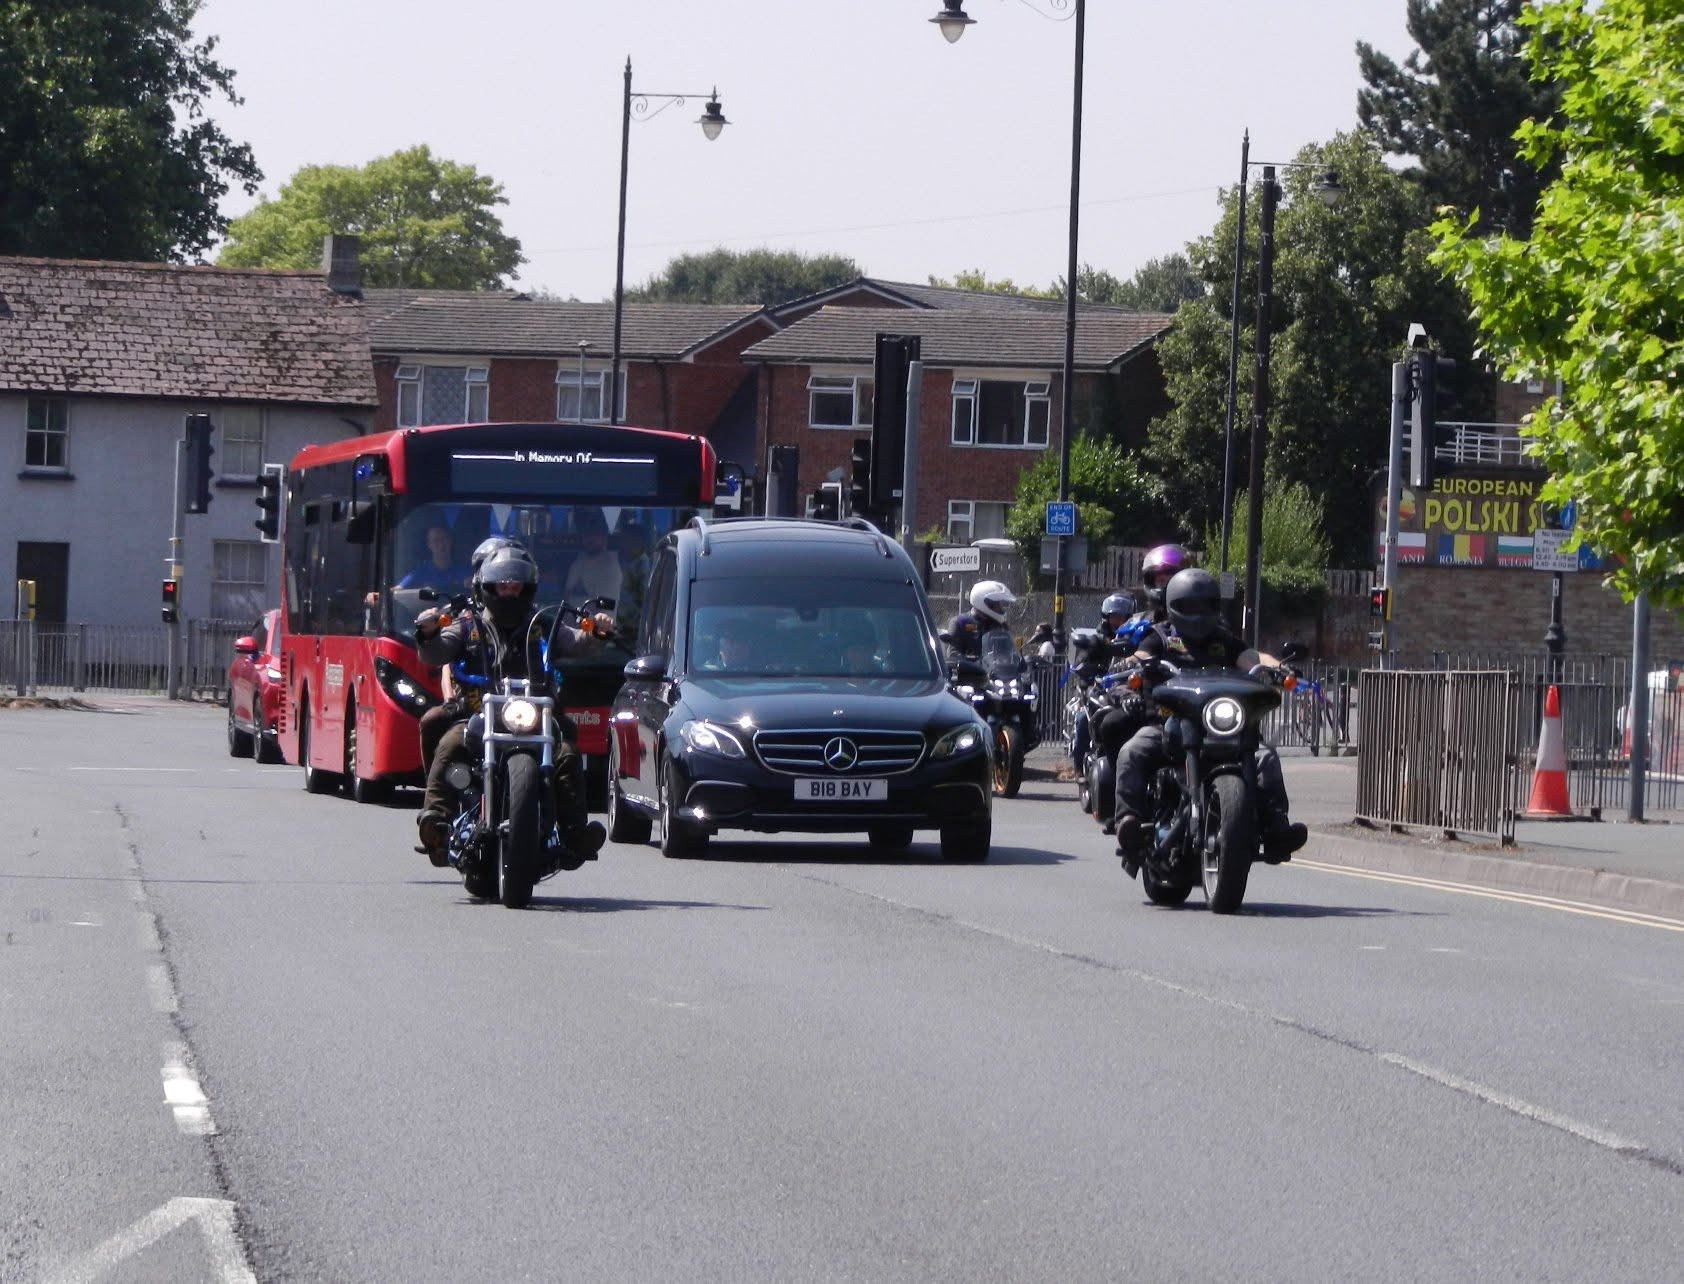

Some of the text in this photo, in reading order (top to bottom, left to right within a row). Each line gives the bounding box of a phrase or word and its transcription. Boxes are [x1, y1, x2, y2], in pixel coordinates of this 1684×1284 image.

[1432, 478, 1533, 496] EUROPEAN
[1424, 498, 1519, 533] POLSKI
[939, 552, 978, 567] Superstore
[1439, 554, 1486, 566] ROMANIA
[1498, 556, 1534, 567] BULGAR
[810, 781, 872, 797] B18 BAY
